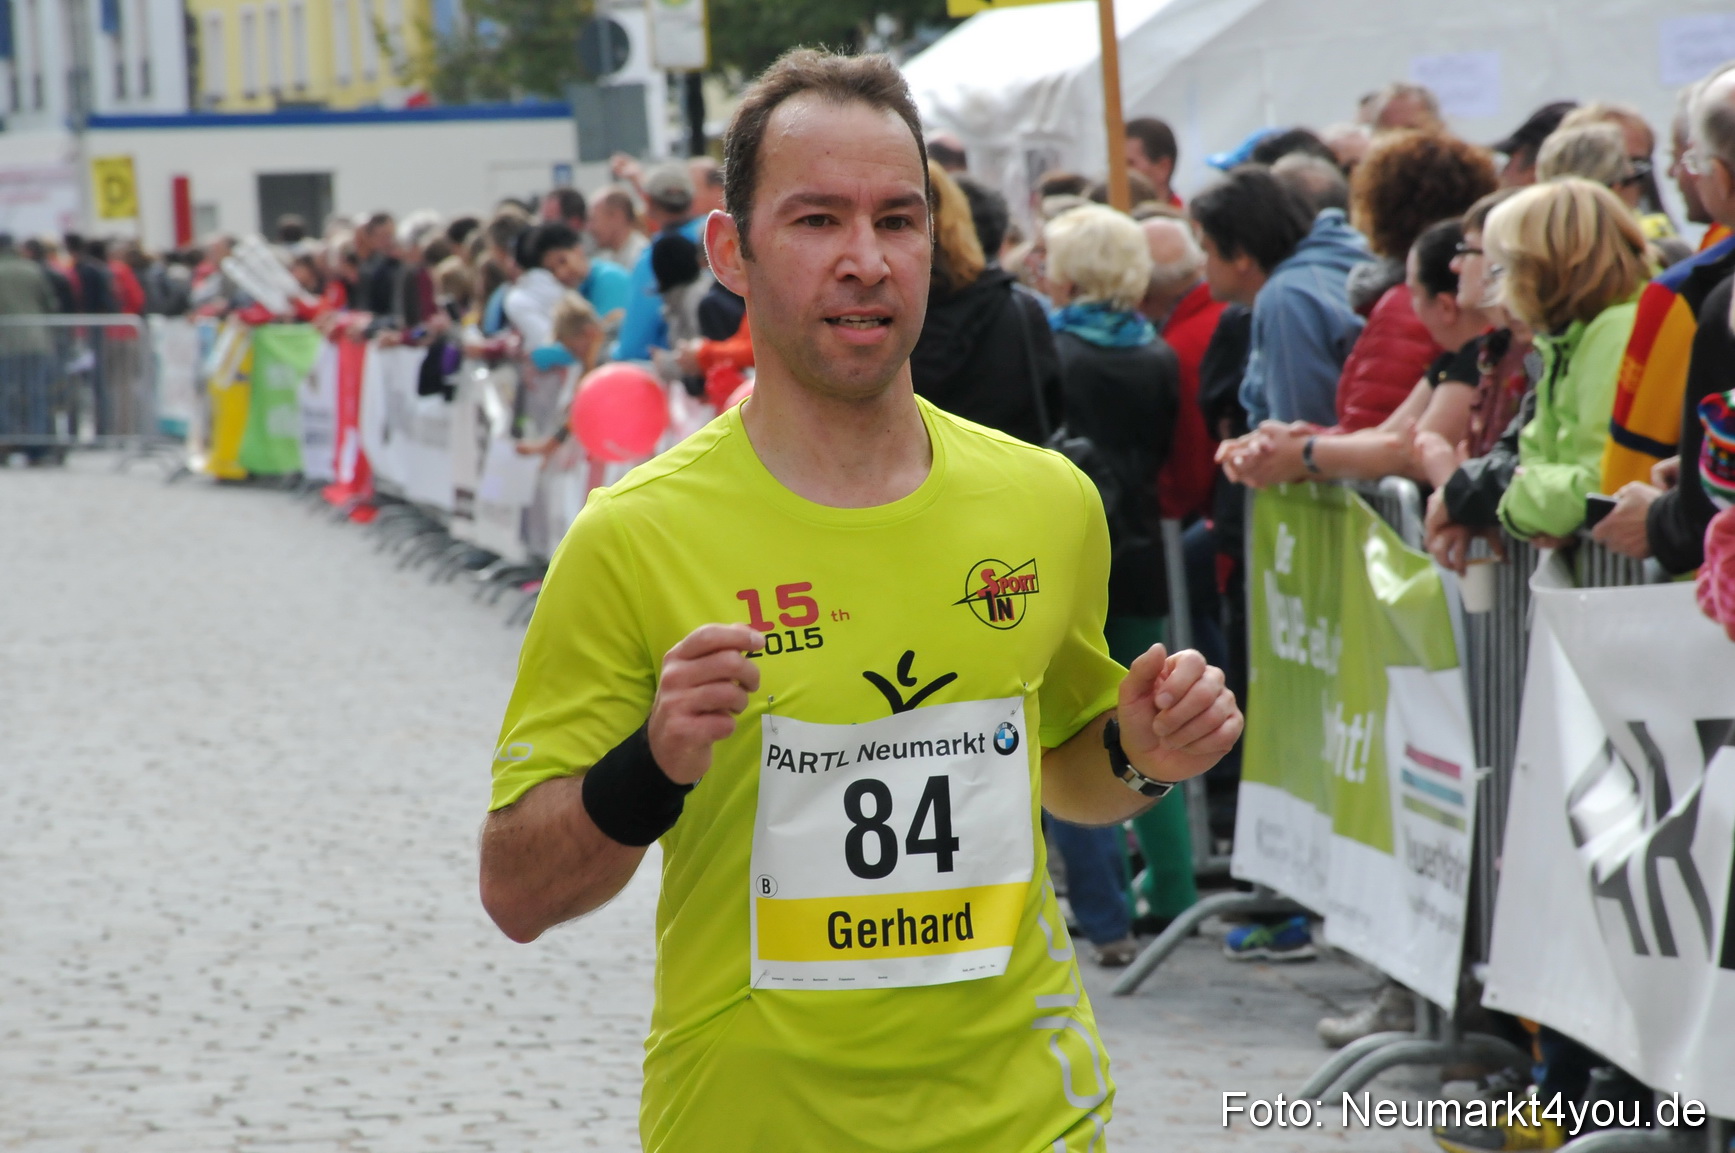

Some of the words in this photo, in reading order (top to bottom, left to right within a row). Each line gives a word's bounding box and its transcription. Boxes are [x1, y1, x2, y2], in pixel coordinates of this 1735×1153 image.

[976, 568, 1035, 597] SPORT
[736, 582, 819, 632] 15
[831, 609, 850, 622] th
[766, 743, 850, 774] PARTL
[856, 731, 986, 763] Neumarkt
[843, 775, 960, 880] 84
[762, 878, 771, 894] B
[827, 902, 974, 950] Gerhard
